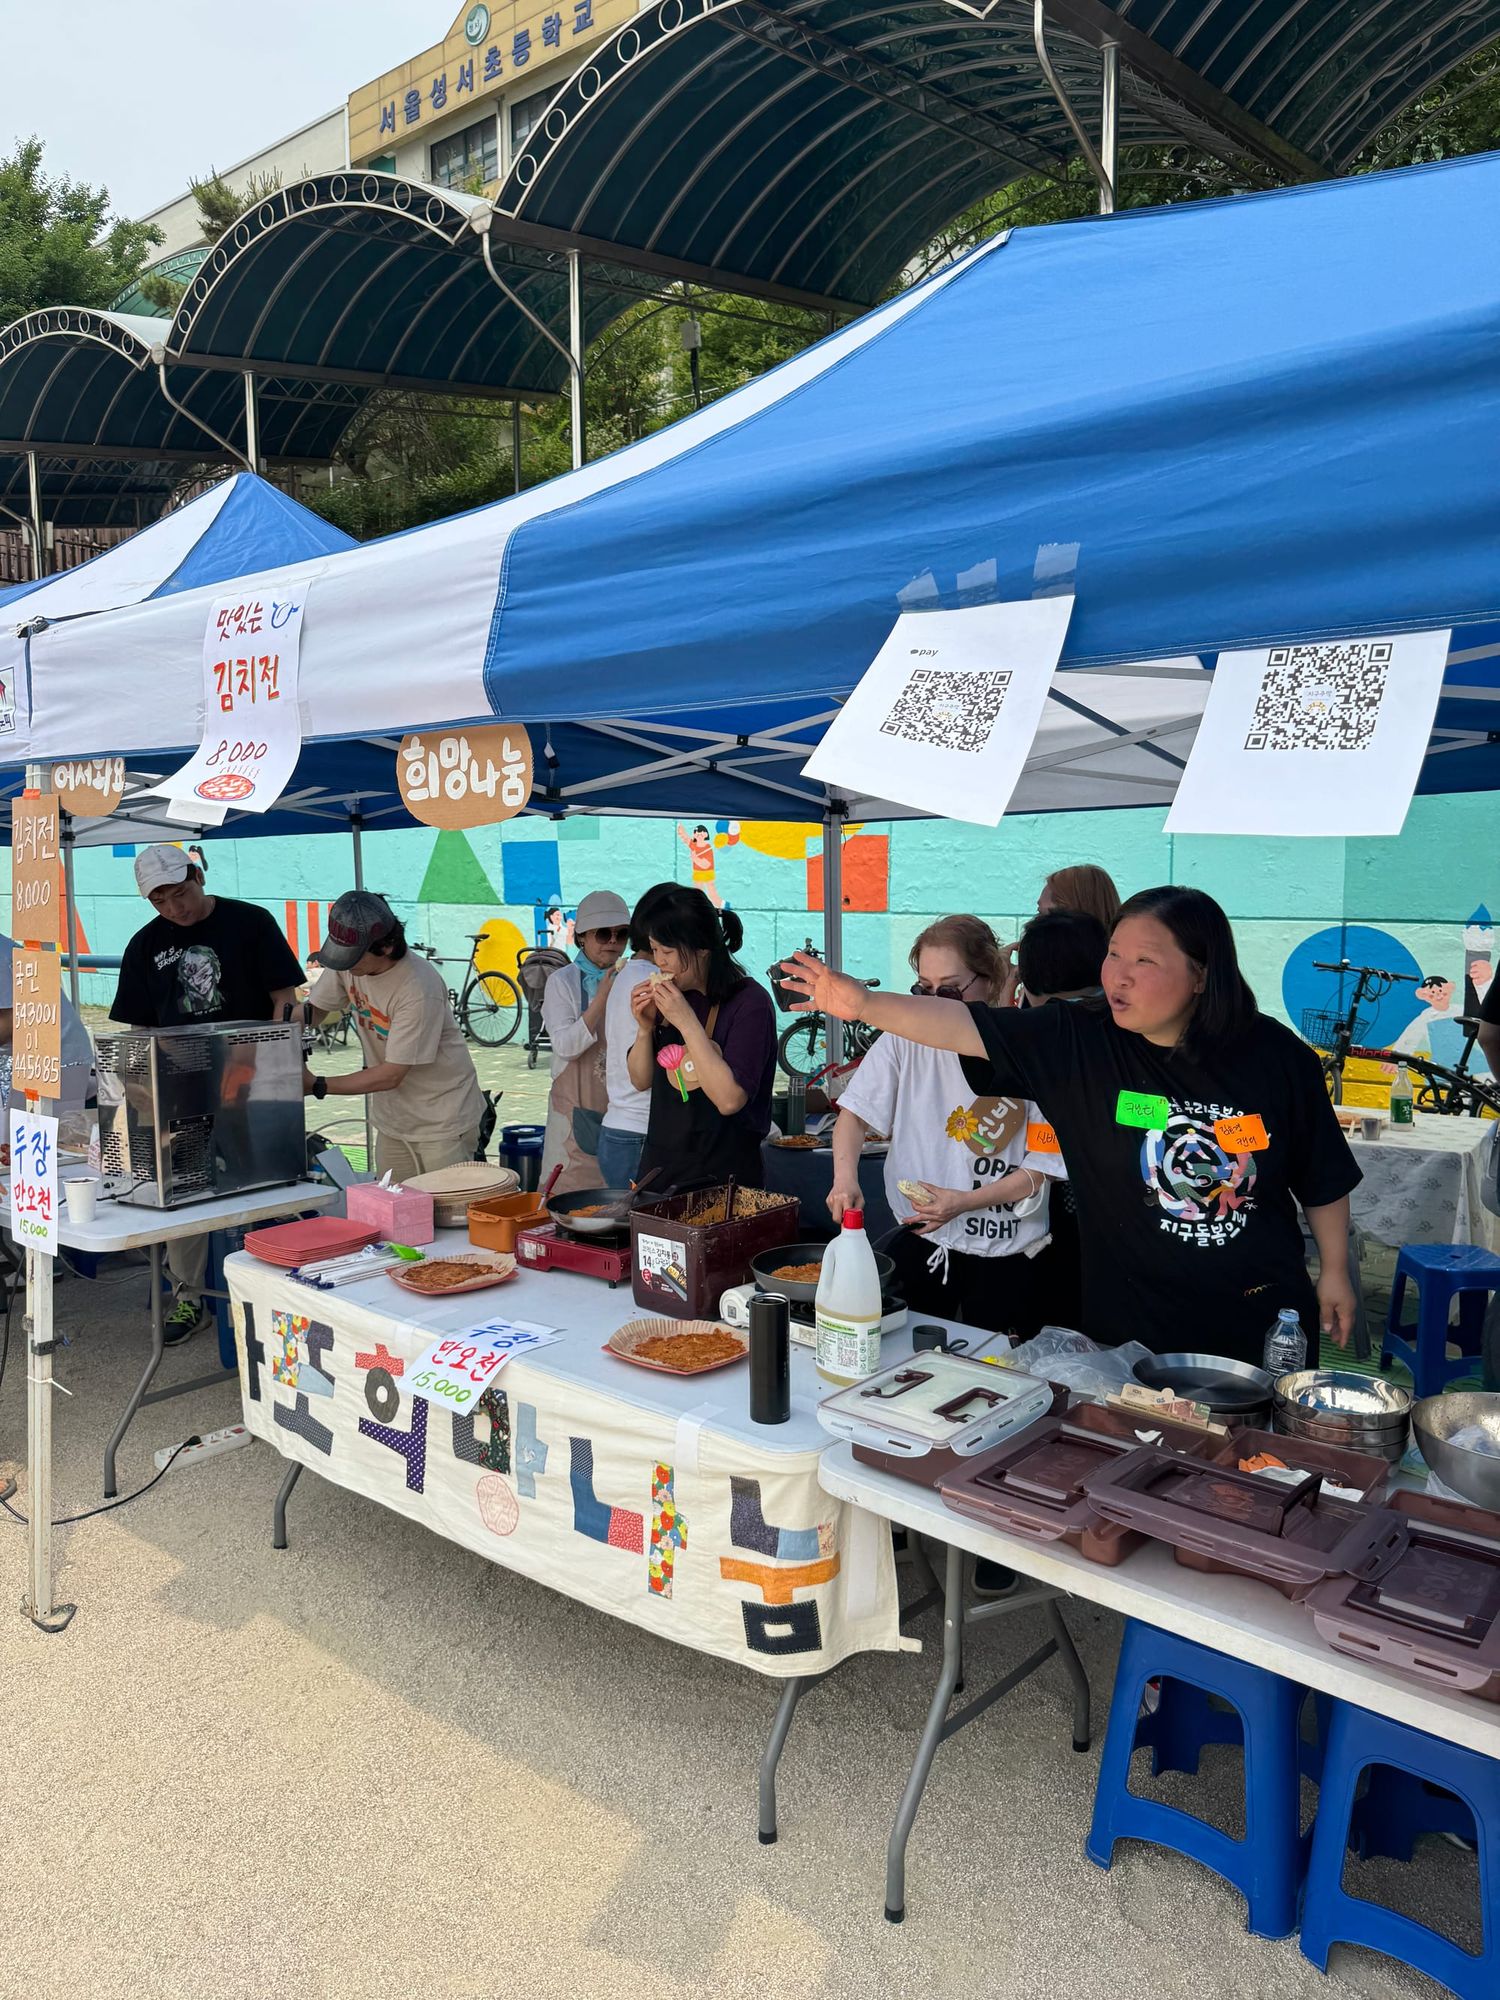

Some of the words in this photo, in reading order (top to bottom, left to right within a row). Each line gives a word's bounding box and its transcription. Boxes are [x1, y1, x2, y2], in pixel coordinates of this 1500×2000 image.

[379, 0, 594, 134] 서울성서초등학교
[216, 601, 264, 643] 맛있는
[918, 647, 939, 658] pay
[213, 655, 281, 713] 김치전
[206, 739, 268, 767] 8,000
[402, 735, 526, 807] 희망나눔
[13, 813, 57, 865] 김치전
[15, 960, 40, 995] 국민
[25, 1032, 38, 1051] 01
[15, 1053, 60, 1084] 445685
[13, 1178, 53, 1221] 만오천
[964, 1216, 1022, 1240] SIGHT
[1159, 1209, 1248, 1247] 지구돌봄으로
[431, 1339, 509, 1382] 만오천
[410, 1370, 472, 1404] 15,000
